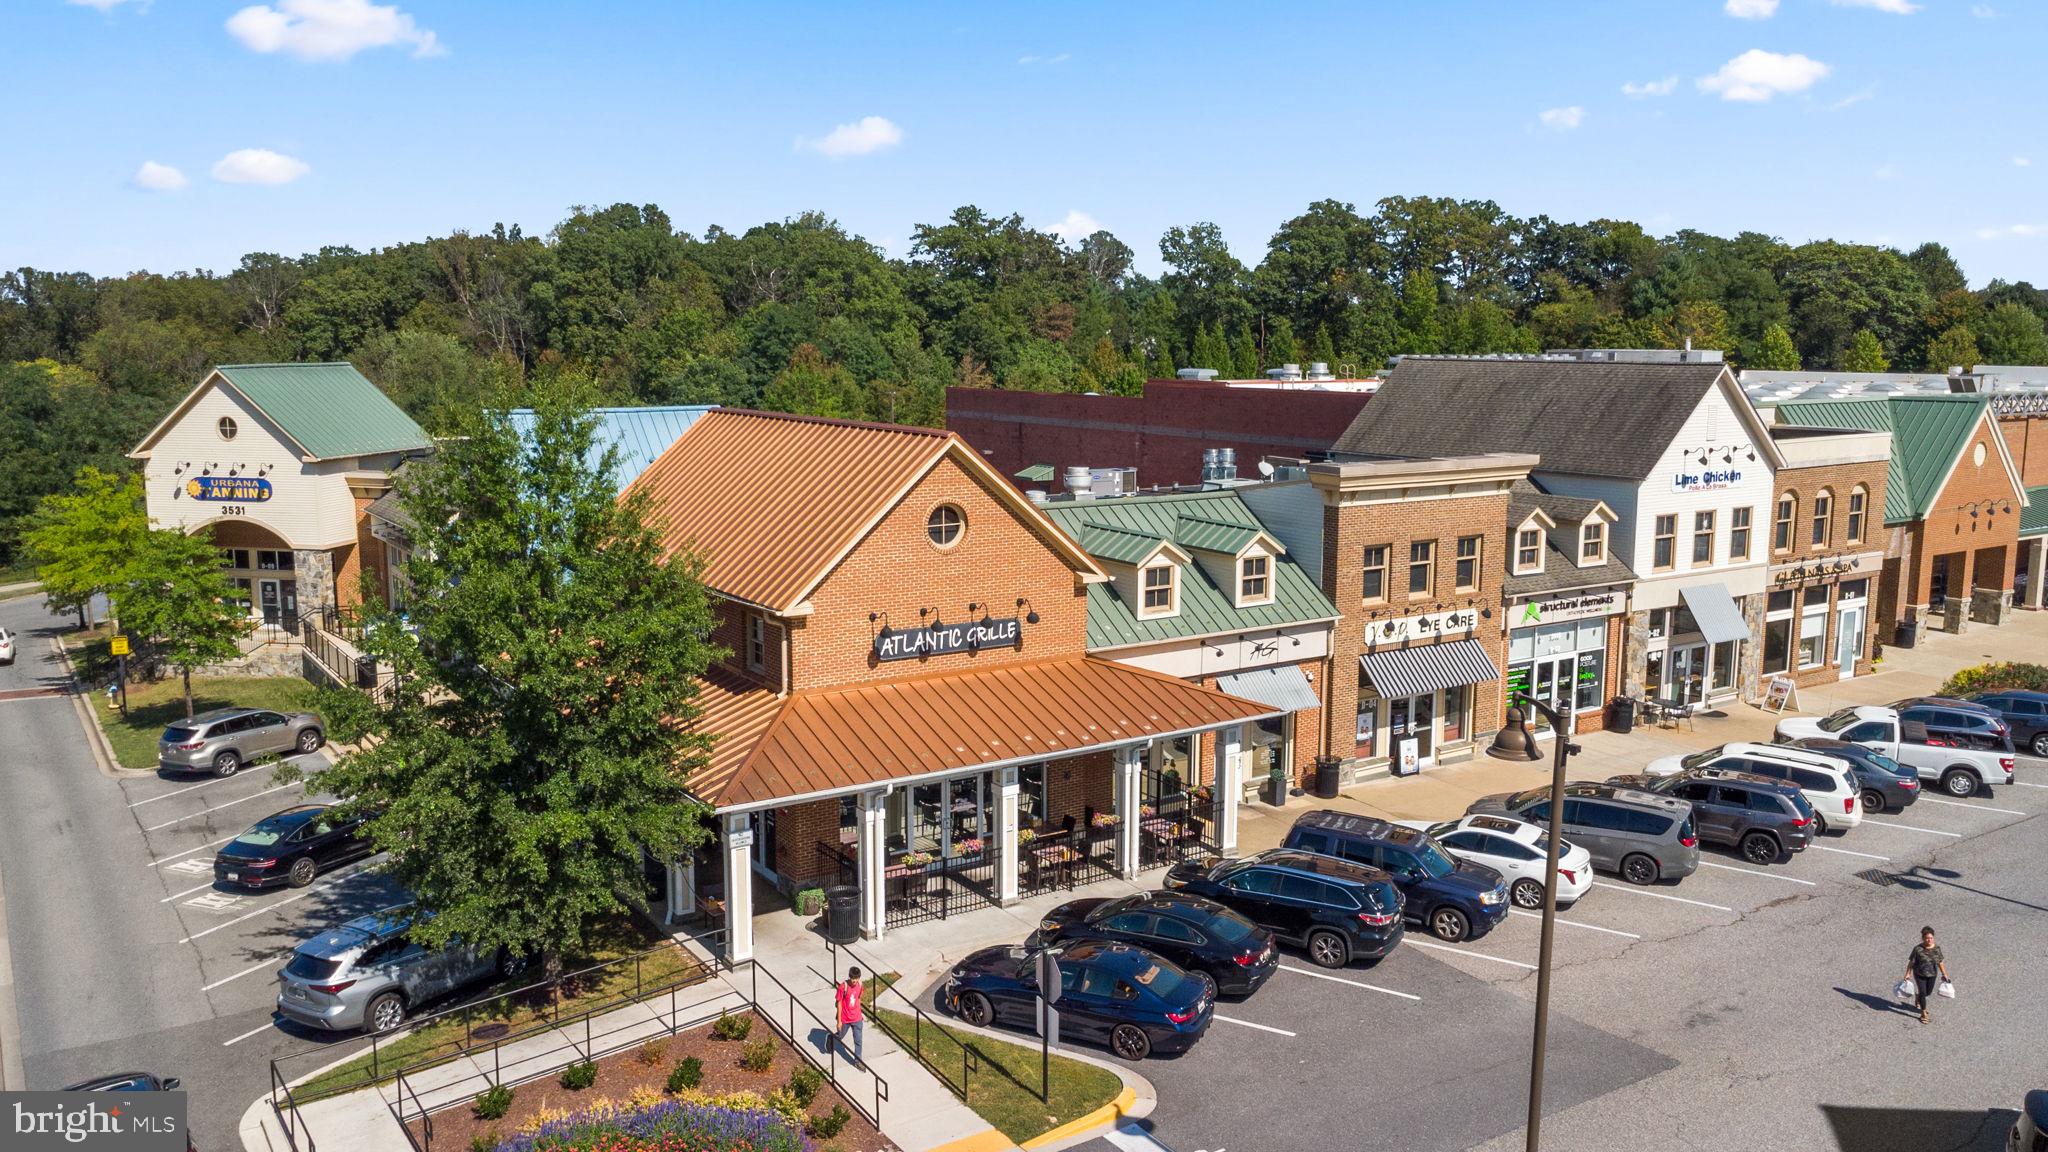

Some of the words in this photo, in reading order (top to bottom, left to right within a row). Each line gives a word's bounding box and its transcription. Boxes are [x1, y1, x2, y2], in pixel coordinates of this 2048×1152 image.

[210, 479, 260, 488] URBANA
[1675, 474, 1698, 485] Lime
[1703, 471, 1741, 483] Chicken
[221, 506, 246, 515] 3531
[1539, 598, 1579, 613] structural
[1580, 594, 1614, 607] elements
[880, 628, 963, 656] ATLANTIC
[967, 621, 1016, 647] GRILLE
